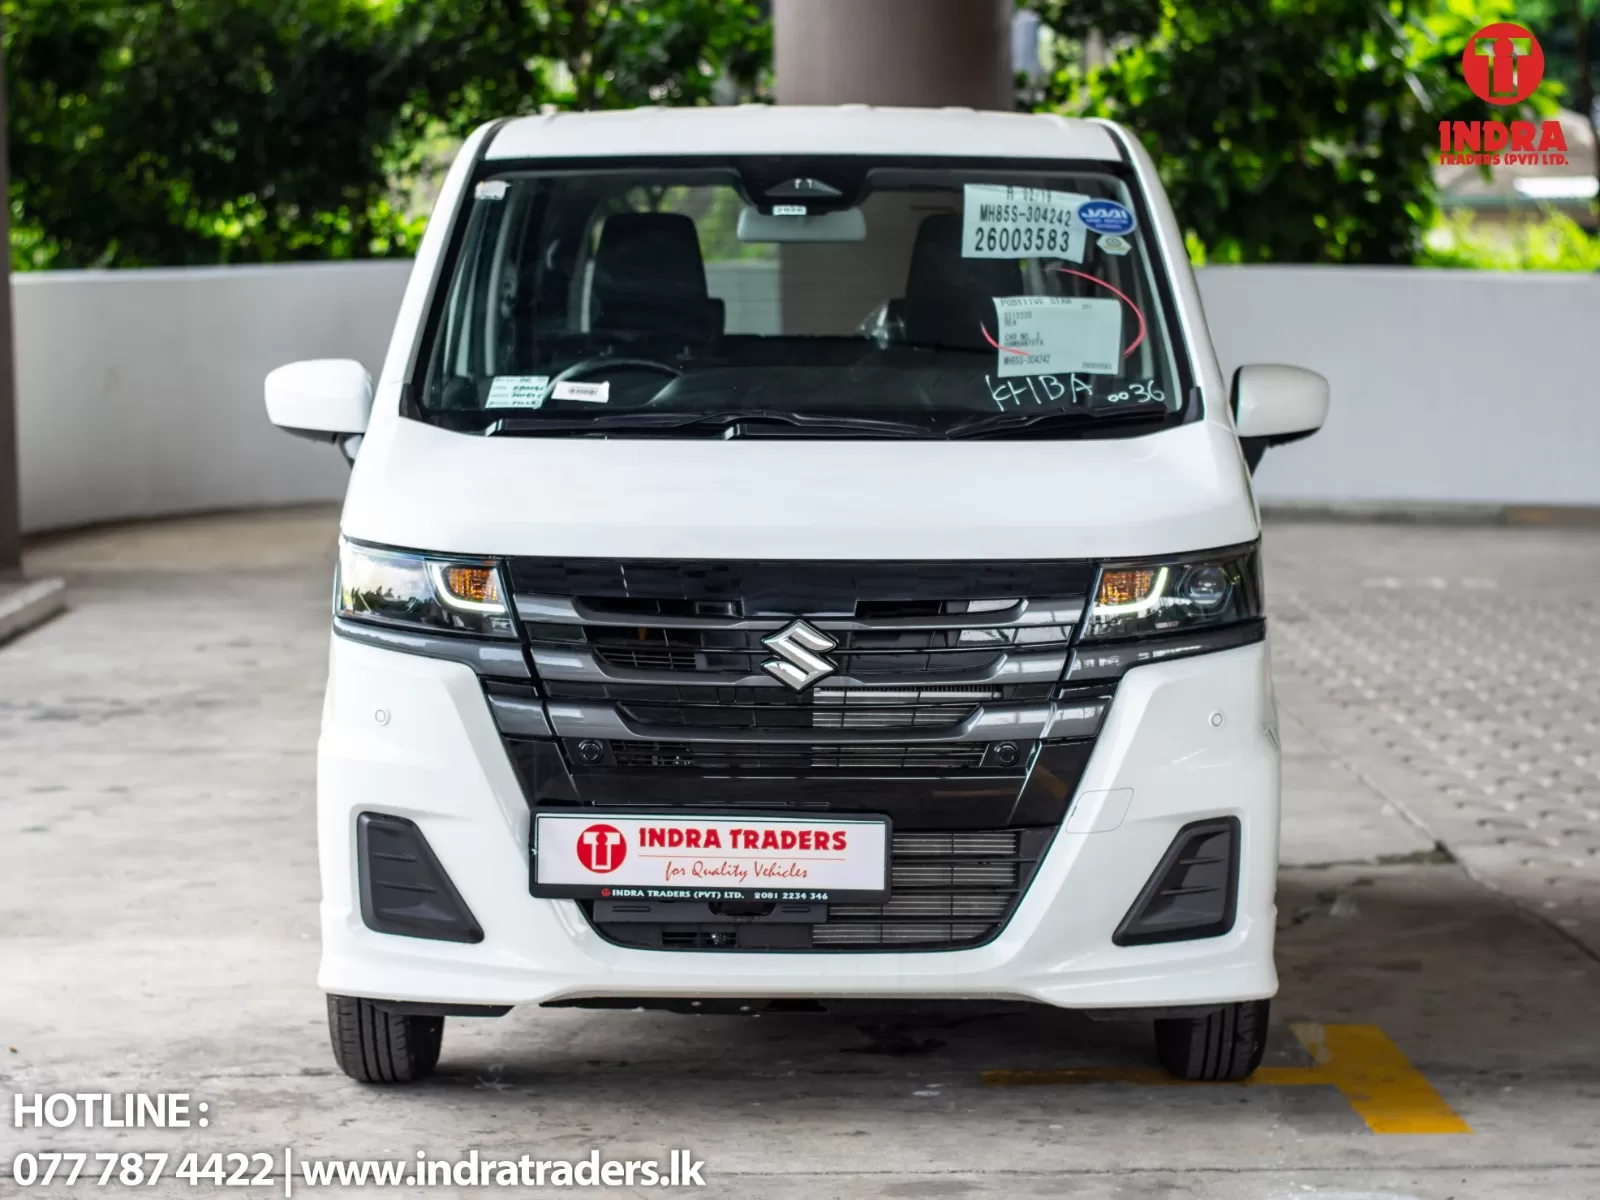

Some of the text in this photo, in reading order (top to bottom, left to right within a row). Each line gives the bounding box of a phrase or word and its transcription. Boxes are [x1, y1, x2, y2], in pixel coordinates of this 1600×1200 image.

[979, 204, 1072, 227] MH85S-304242
[975, 227, 1070, 252] 26003583
[638, 827, 848, 851] INDRA TRADERS
[665, 860, 808, 883] for Quality Vehicles
[612, 889, 645, 897] INDRA
[647, 890, 691, 898] TRADERS
[694, 890, 721, 899] (PVT)
[724, 891, 745, 899] LTD.
[782, 892, 807, 900] 2234
[810, 892, 828, 900] 346
